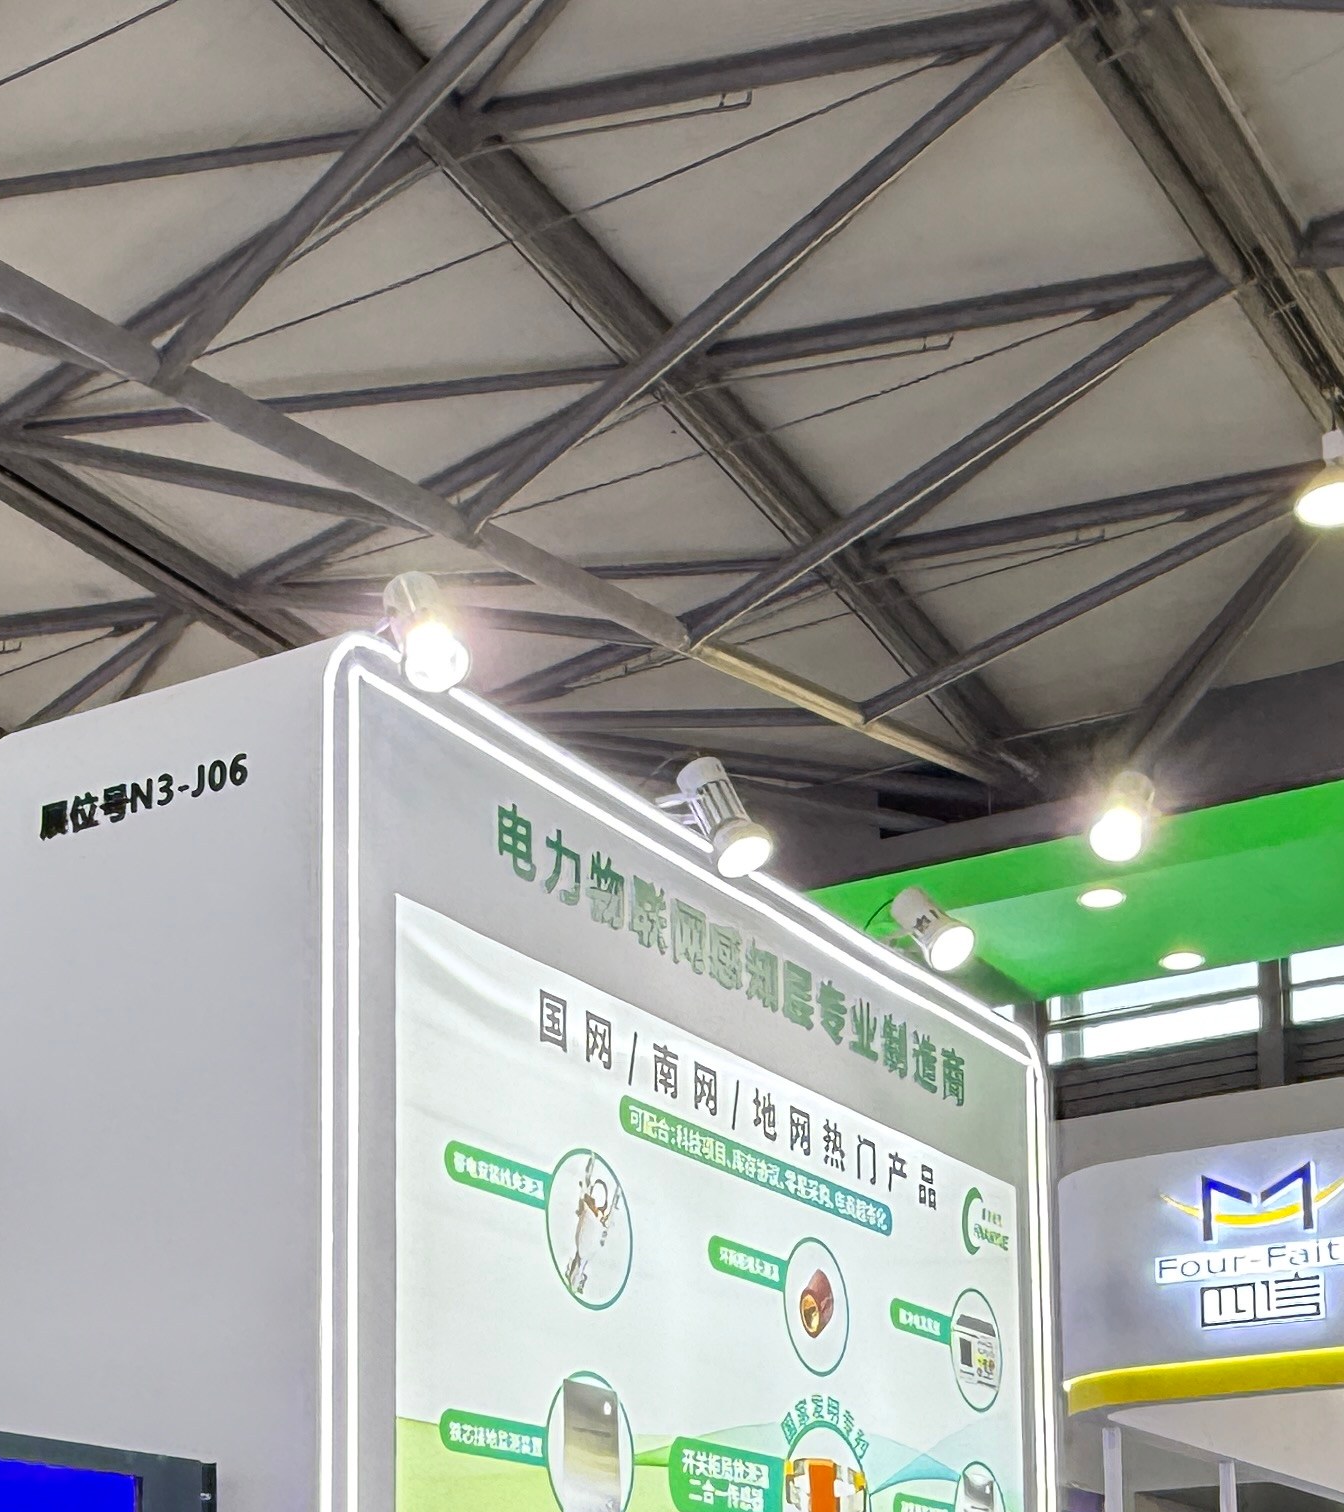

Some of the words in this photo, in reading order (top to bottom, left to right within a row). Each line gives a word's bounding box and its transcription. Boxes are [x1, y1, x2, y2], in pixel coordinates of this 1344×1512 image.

[39, 753, 249, 841] 展位号N3-J06
[496, 802, 966, 1107] 电力物联网感知层专业制造商
[539, 989, 938, 1210] 国网/南网/地网热门产品
[1201, 1272, 1323, 1328] 四信
